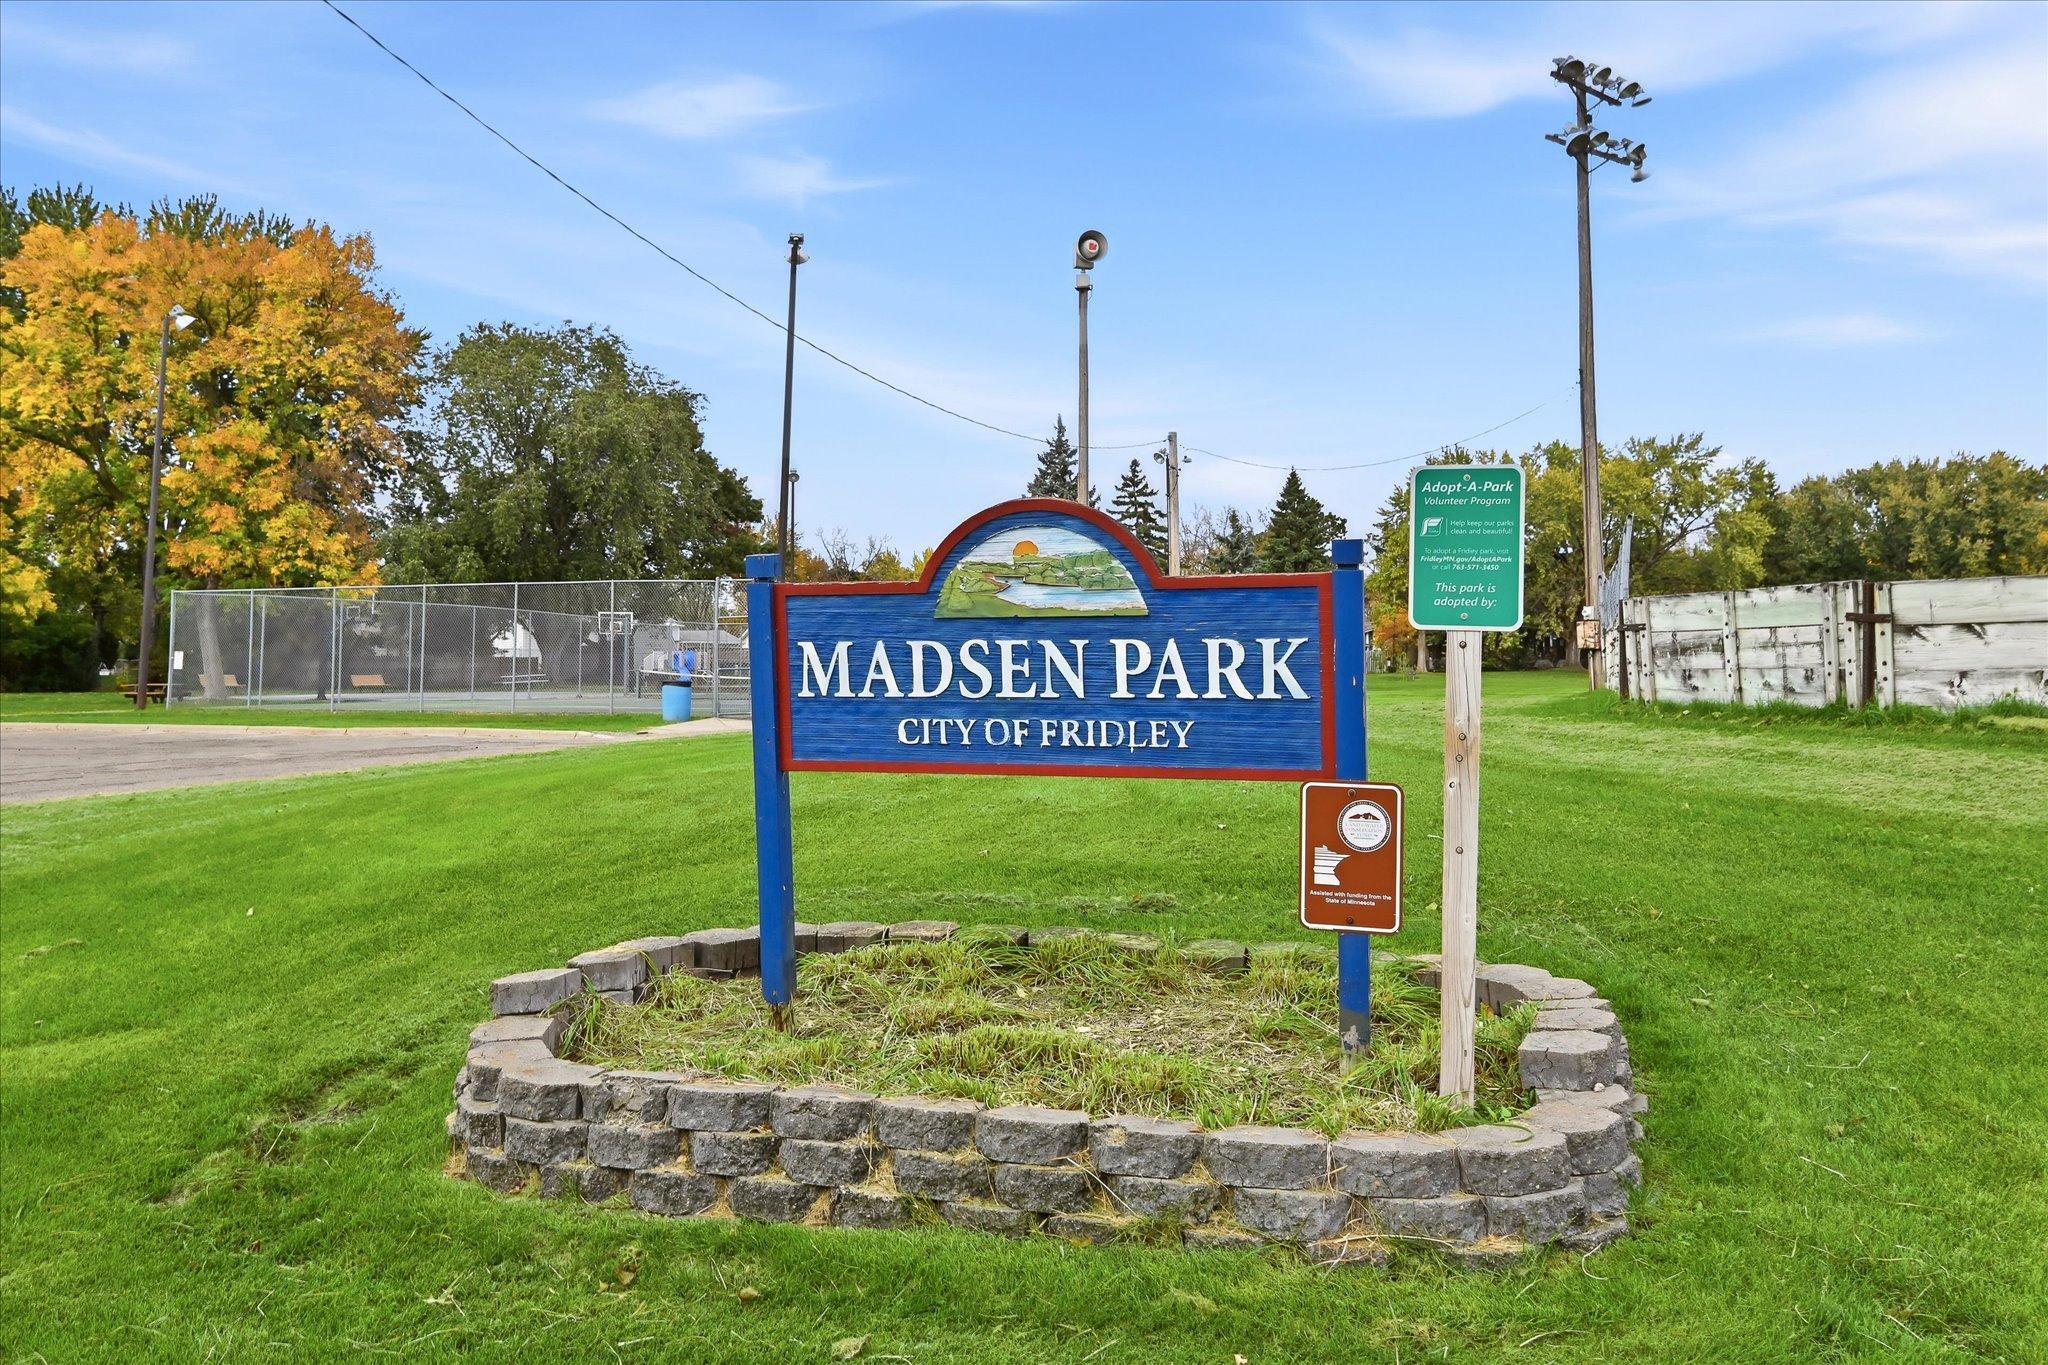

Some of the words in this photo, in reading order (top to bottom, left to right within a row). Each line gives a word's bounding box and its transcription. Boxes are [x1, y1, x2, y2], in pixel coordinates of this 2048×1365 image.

[1421, 481, 1514, 495] Adopt-A-Park
[1424, 497, 1468, 505] Volunteer
[1470, 497, 1511, 507] Program
[1435, 583, 1457, 593] This
[1459, 583, 1485, 595] park
[1488, 583, 1497, 593] is
[1433, 597, 1479, 608] adopted
[1481, 597, 1498, 609] by:
[796, 640, 1090, 699] MADSEN
[1109, 637, 1312, 700] PARK
[897, 718, 976, 746] CITY
[984, 718, 1029, 746] OF
[1040, 719, 1196, 753] FRIDLEY
[1346, 892, 1368, 900] funding
